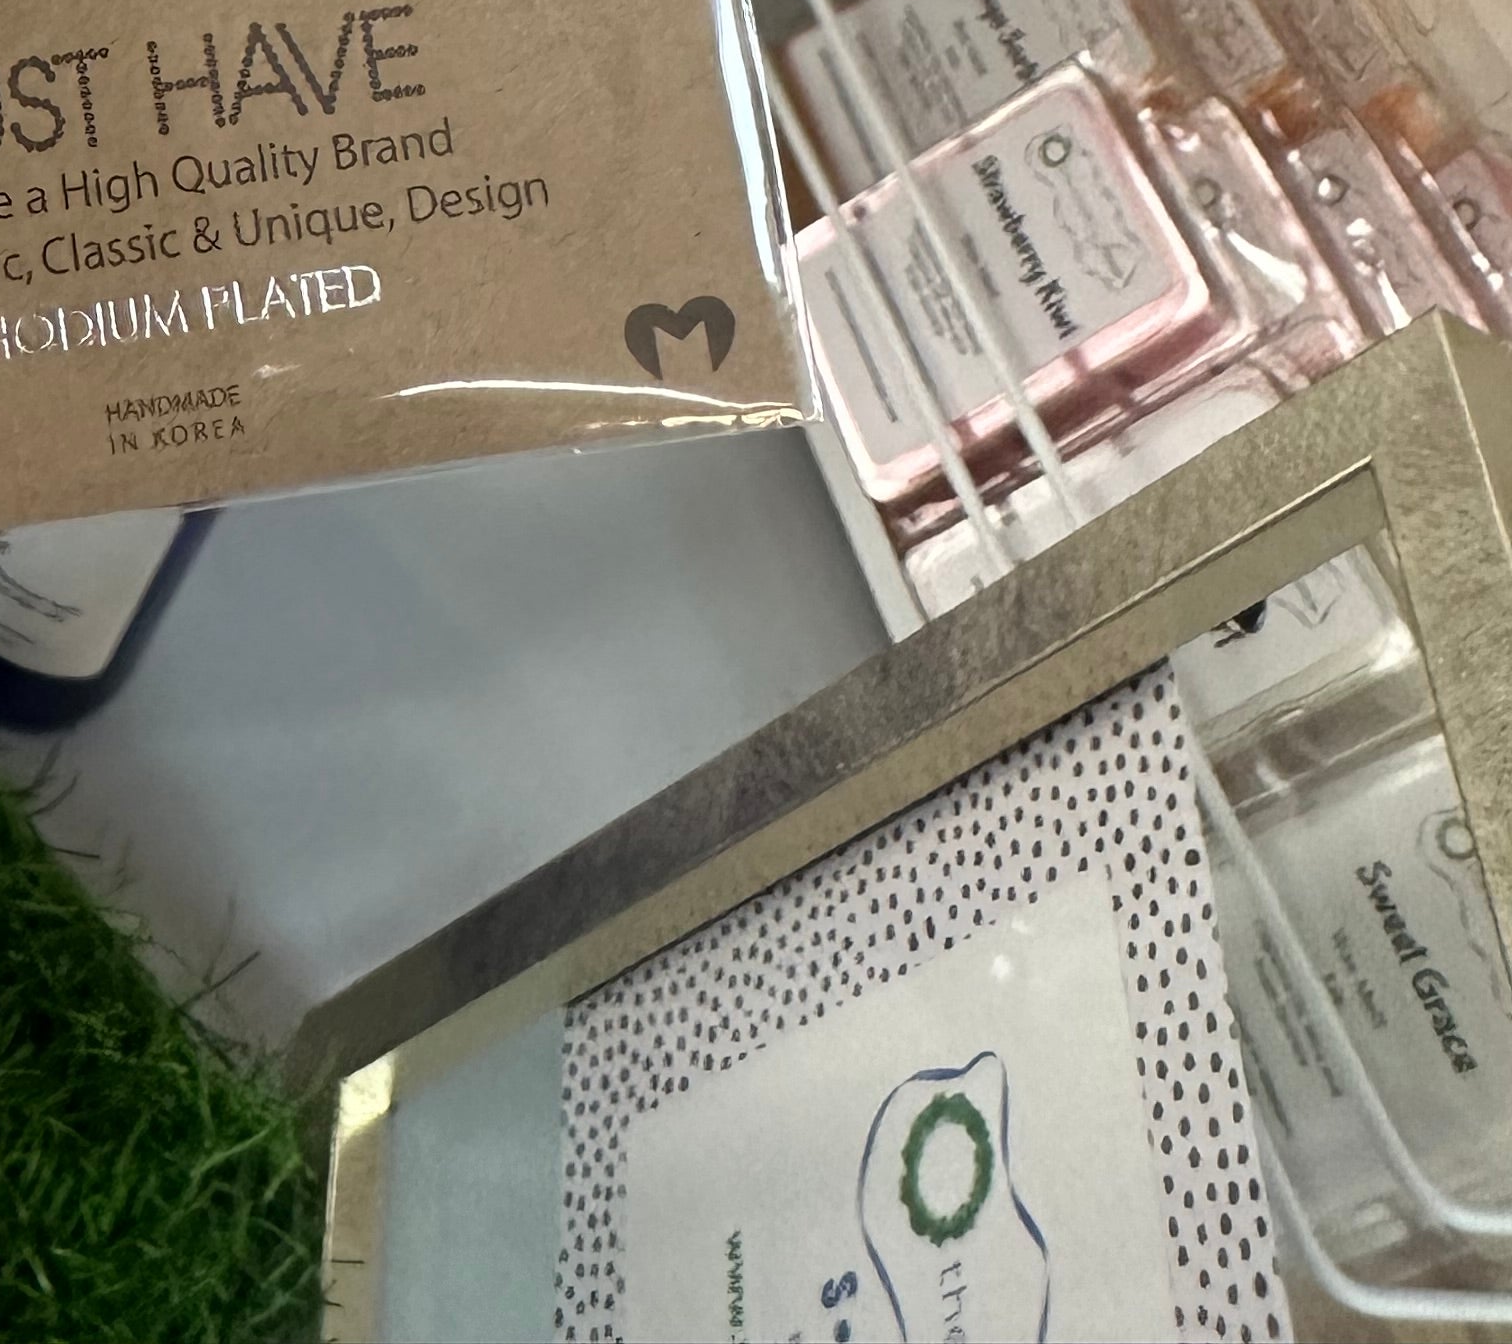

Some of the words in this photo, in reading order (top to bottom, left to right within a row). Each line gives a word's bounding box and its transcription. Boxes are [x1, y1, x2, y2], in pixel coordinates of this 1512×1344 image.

[146, 4, 426, 136] HAVE
[26, 186, 49, 215] a
[60, 160, 160, 214] High
[172, 142, 319, 195] Quality
[332, 117, 454, 171] Brand
[41, 223, 181, 274] Classic
[193, 216, 223, 254] &
[233, 201, 395, 246] Unique,
[407, 174, 550, 224] Design
[971, 153, 1047, 287] Strawberry
[1034, 276, 1078, 341] Kiwi
[201, 265, 382, 330] PLATED
[103, 384, 242, 424] HANDMADE
[107, 430, 139, 455] IN
[149, 415, 246, 451] KOREA
[1355, 860, 1429, 966] Sweet
[1412, 967, 1479, 1074] Grace
